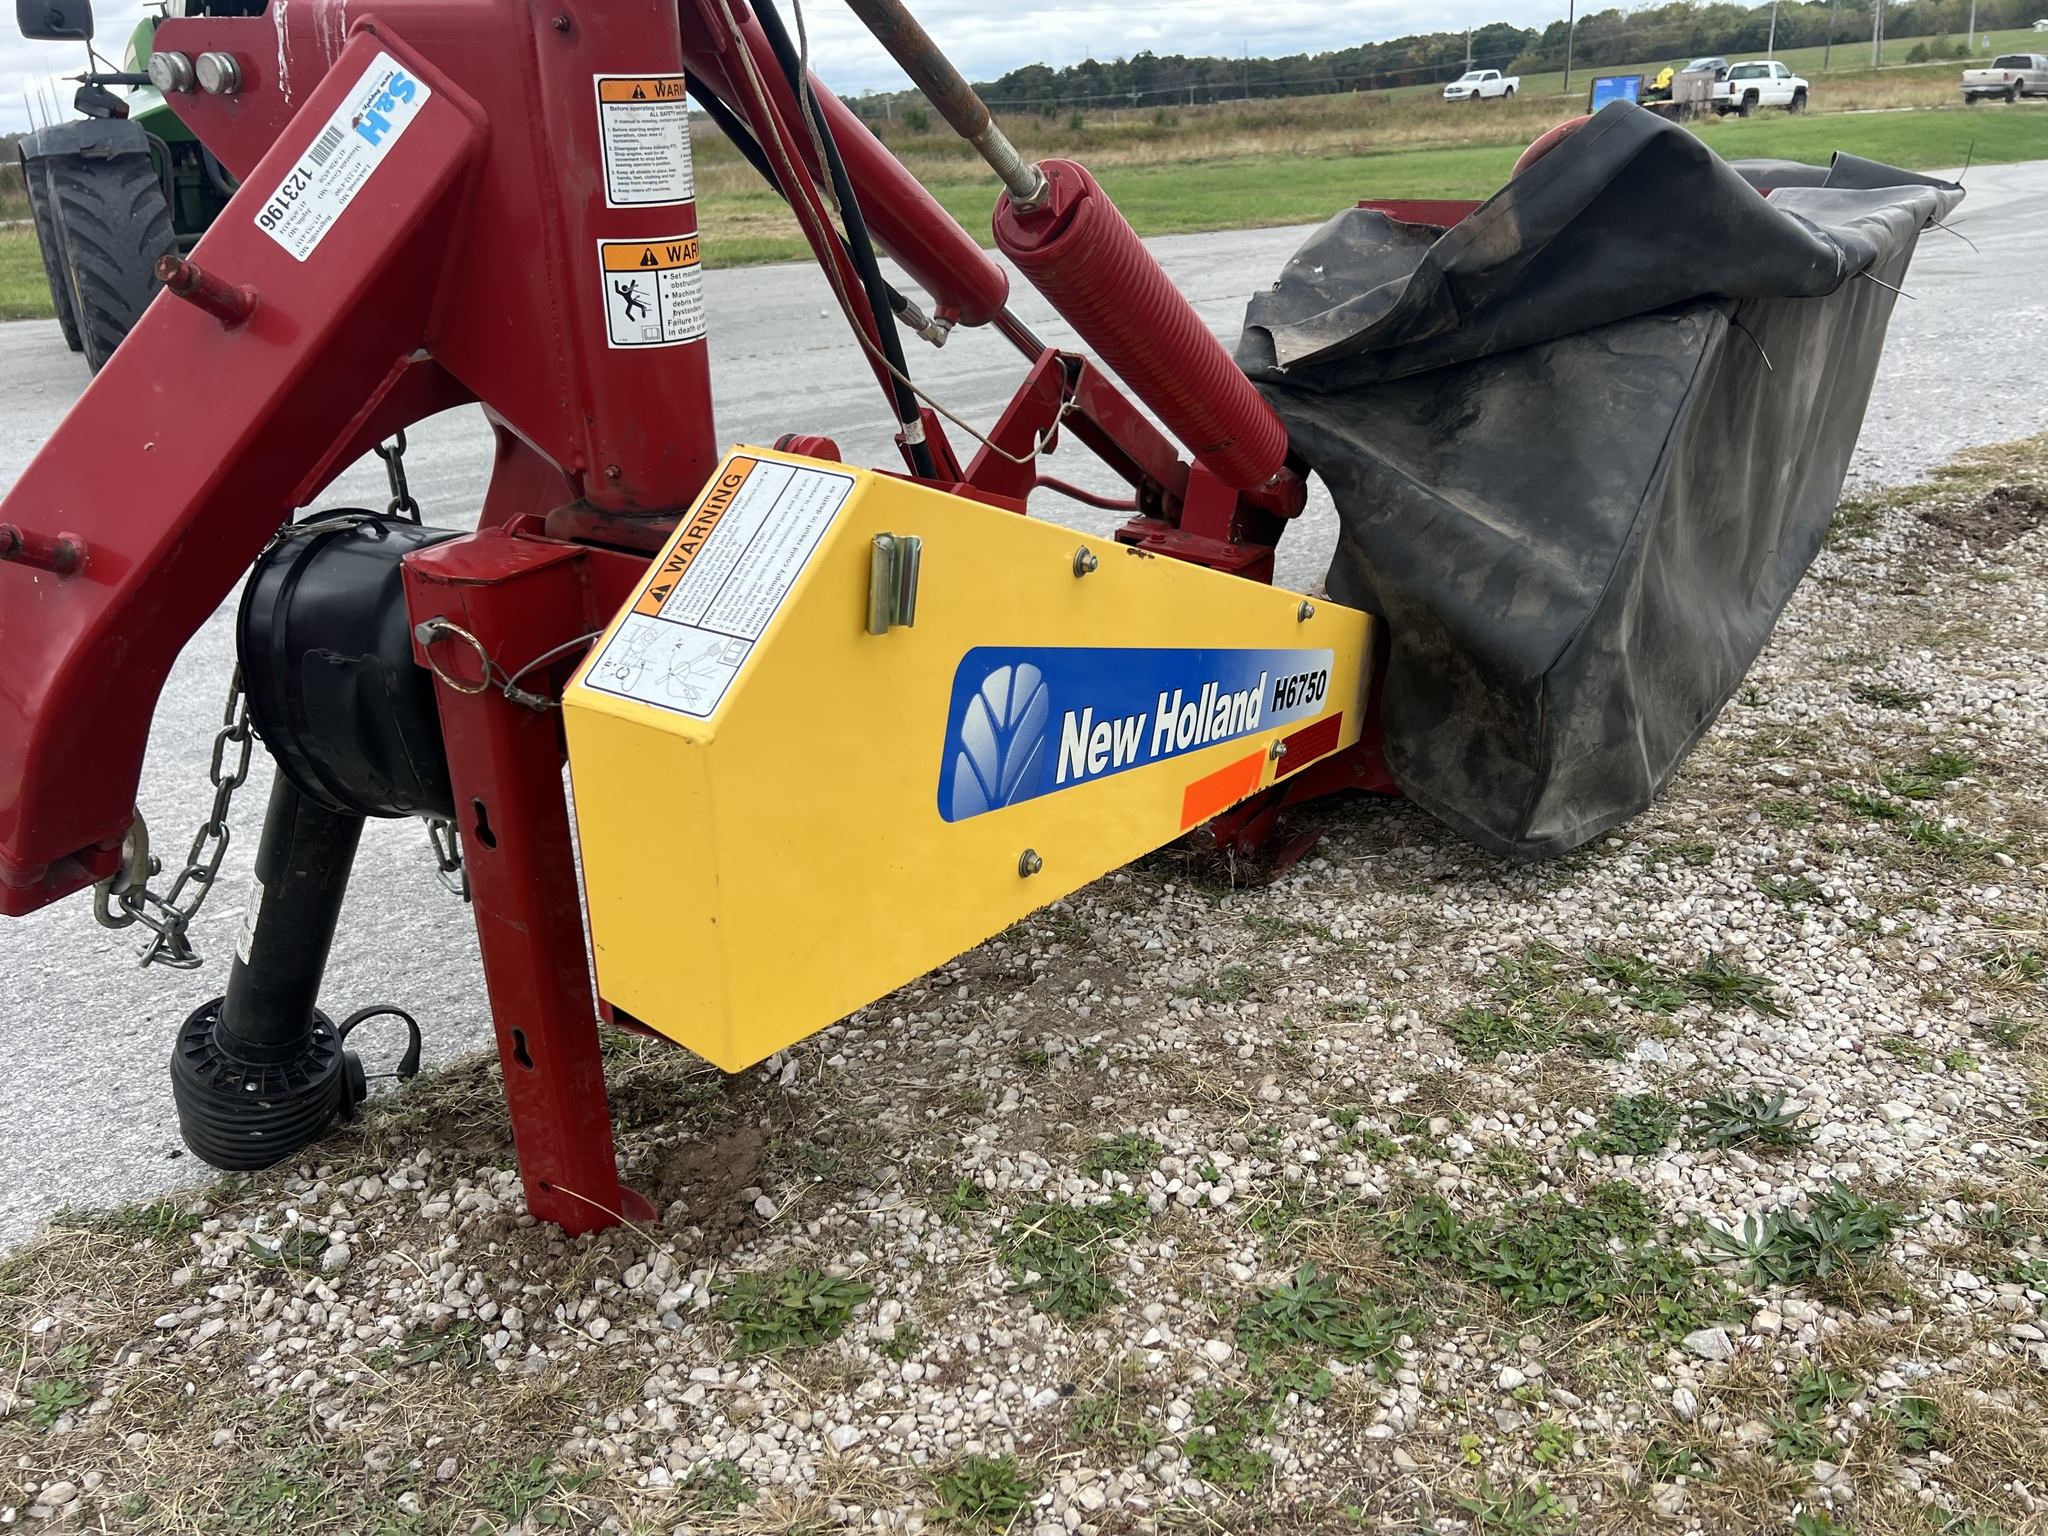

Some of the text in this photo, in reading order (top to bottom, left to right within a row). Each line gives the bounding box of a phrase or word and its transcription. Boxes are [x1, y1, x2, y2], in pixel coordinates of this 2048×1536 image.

[355, 71, 416, 147] S&H
[338, 143, 361, 171] Mountain
[259, 167, 313, 230] 123196
[316, 186, 328, 200] MO
[337, 192, 350, 206] MO
[286, 225, 298, 239] MO
[297, 244, 309, 258] MO
[670, 272, 681, 280] Set
[672, 289, 695, 299] Machine
[667, 318, 691, 327] Failure
[678, 325, 696, 335] death
[664, 474, 742, 573] WARNING
[662, 592, 681, 615] Before
[676, 547, 712, 592] disconnecting
[707, 533, 720, 546] unit
[715, 517, 730, 533] from
[740, 485, 838, 634] Failure to comply could result in death or
[702, 607, 719, 625] After
[714, 575, 740, 607] mounting
[734, 562, 748, 576] unit
[749, 606, 772, 635] serious
[1055, 669, 1327, 785] New Holland H6750
